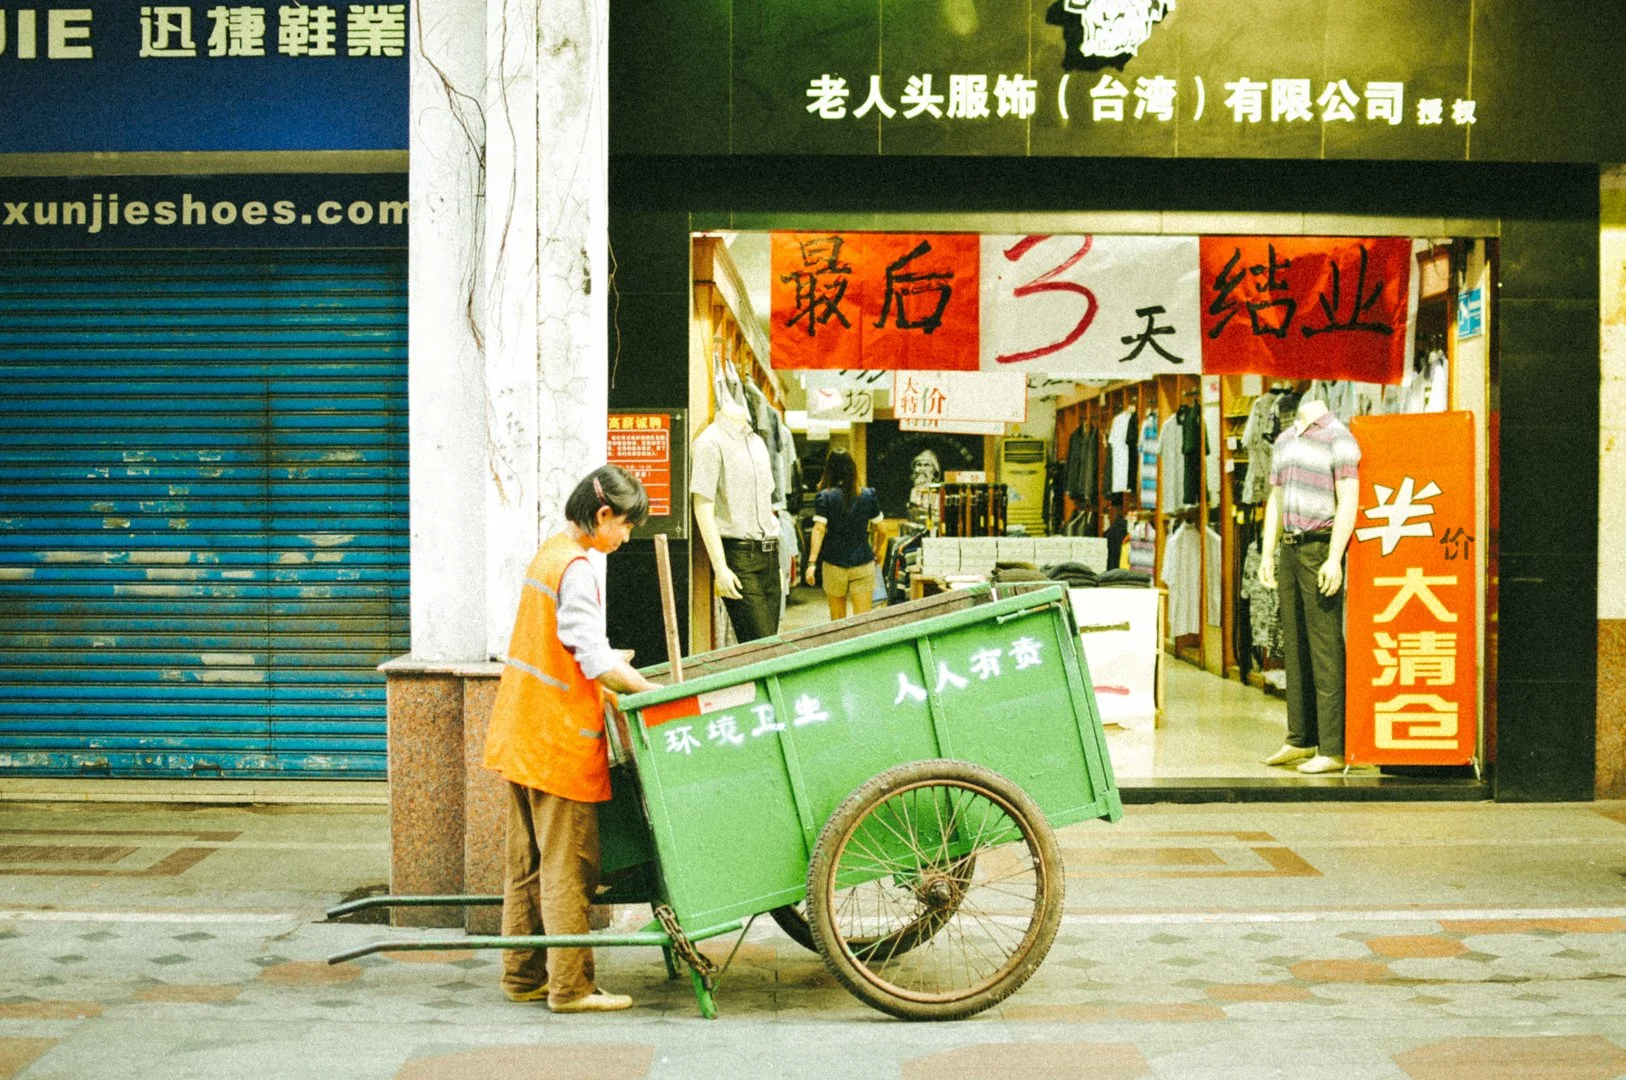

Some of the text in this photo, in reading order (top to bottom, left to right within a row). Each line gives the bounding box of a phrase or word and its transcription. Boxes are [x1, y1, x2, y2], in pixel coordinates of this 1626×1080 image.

[0, 9, 93, 59] IE
[139, 4, 406, 58] 迅捷鞋業
[1416, 98, 1477, 125] 授权
[2, 193, 409, 233] xunjieshoes.com
[1371, 567, 1459, 749] 大清仓
[664, 636, 1043, 755] 环境卫生 人人有责
